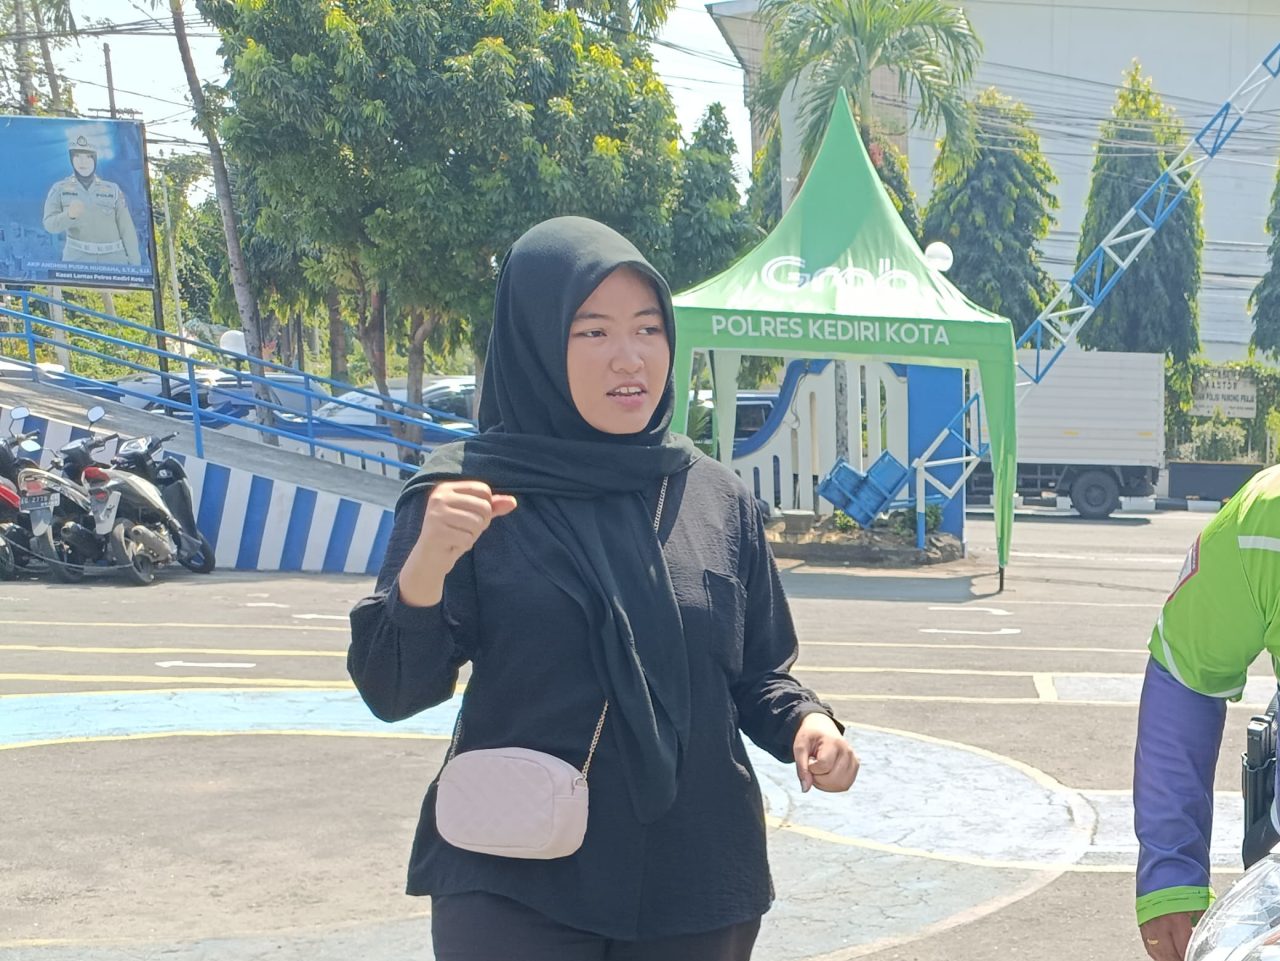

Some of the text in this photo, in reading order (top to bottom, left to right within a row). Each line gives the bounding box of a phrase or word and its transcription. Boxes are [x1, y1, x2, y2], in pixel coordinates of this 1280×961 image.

[761, 255, 919, 294] Grab
[711, 314, 950, 346] POLRES KEDIRI KOTA
